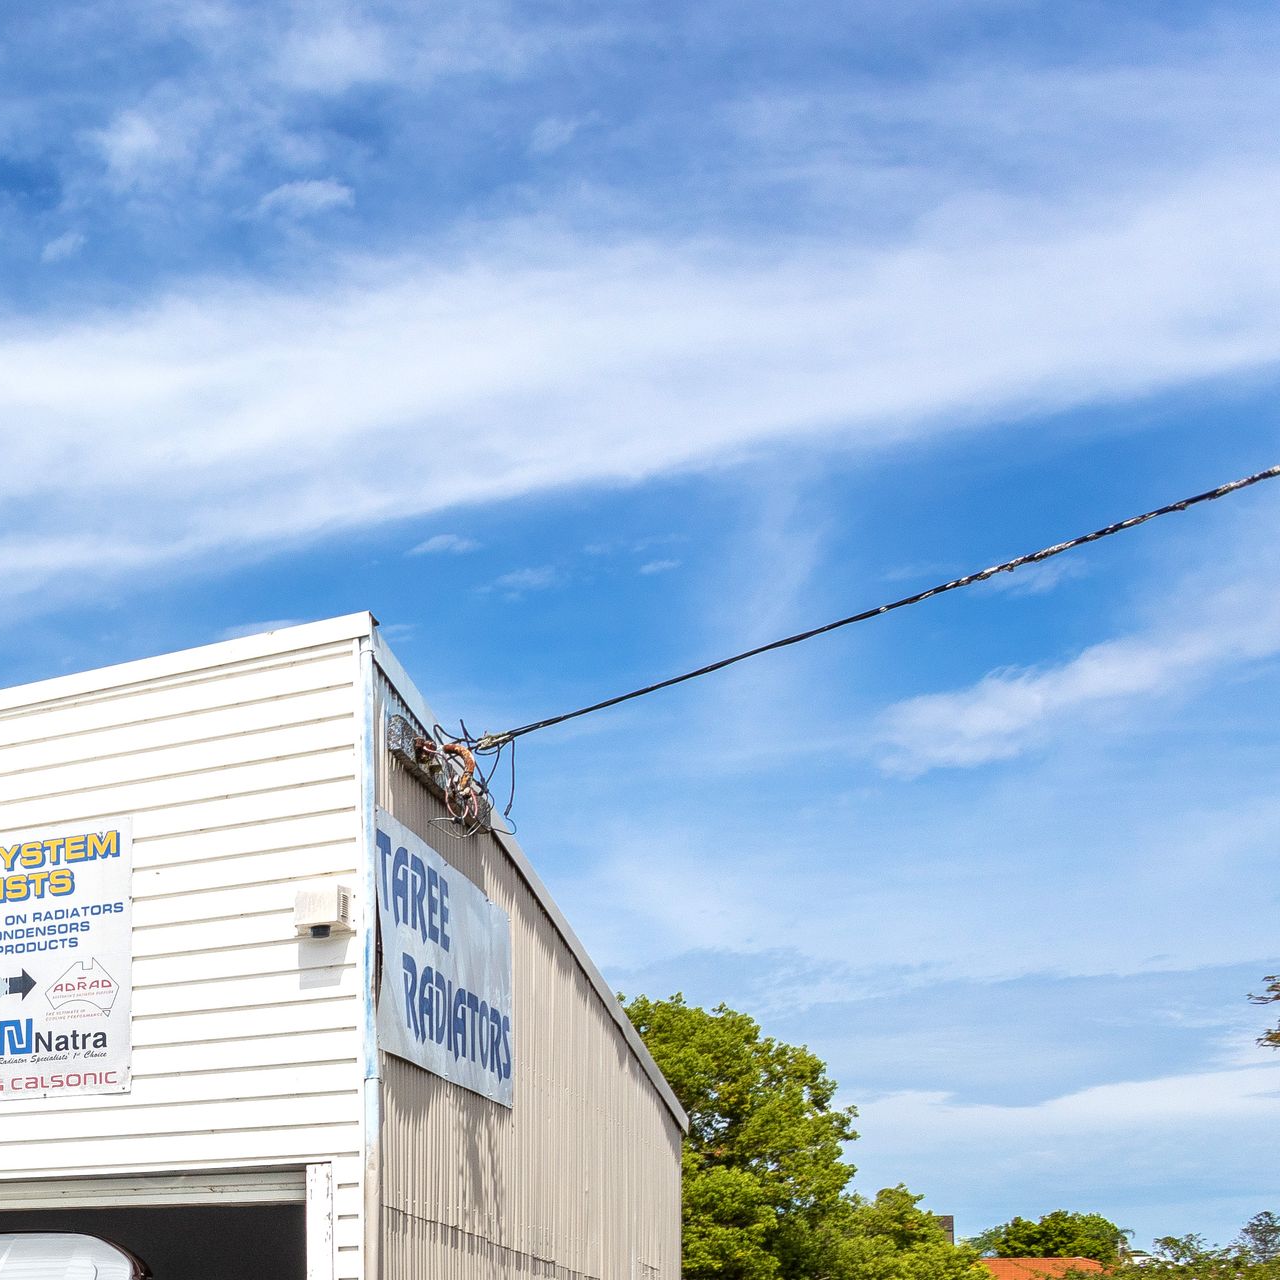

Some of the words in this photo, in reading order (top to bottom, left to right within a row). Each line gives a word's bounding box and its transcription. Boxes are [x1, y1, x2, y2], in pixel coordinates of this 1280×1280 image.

[376, 828, 450, 952] TAREE
[5, 914, 27, 926] ON
[33, 902, 124, 922] RADIATORS
[403, 952, 511, 1083] RADIATORS
[35, 1030, 107, 1053] Natra
[84, 1051, 107, 1059] Choice
